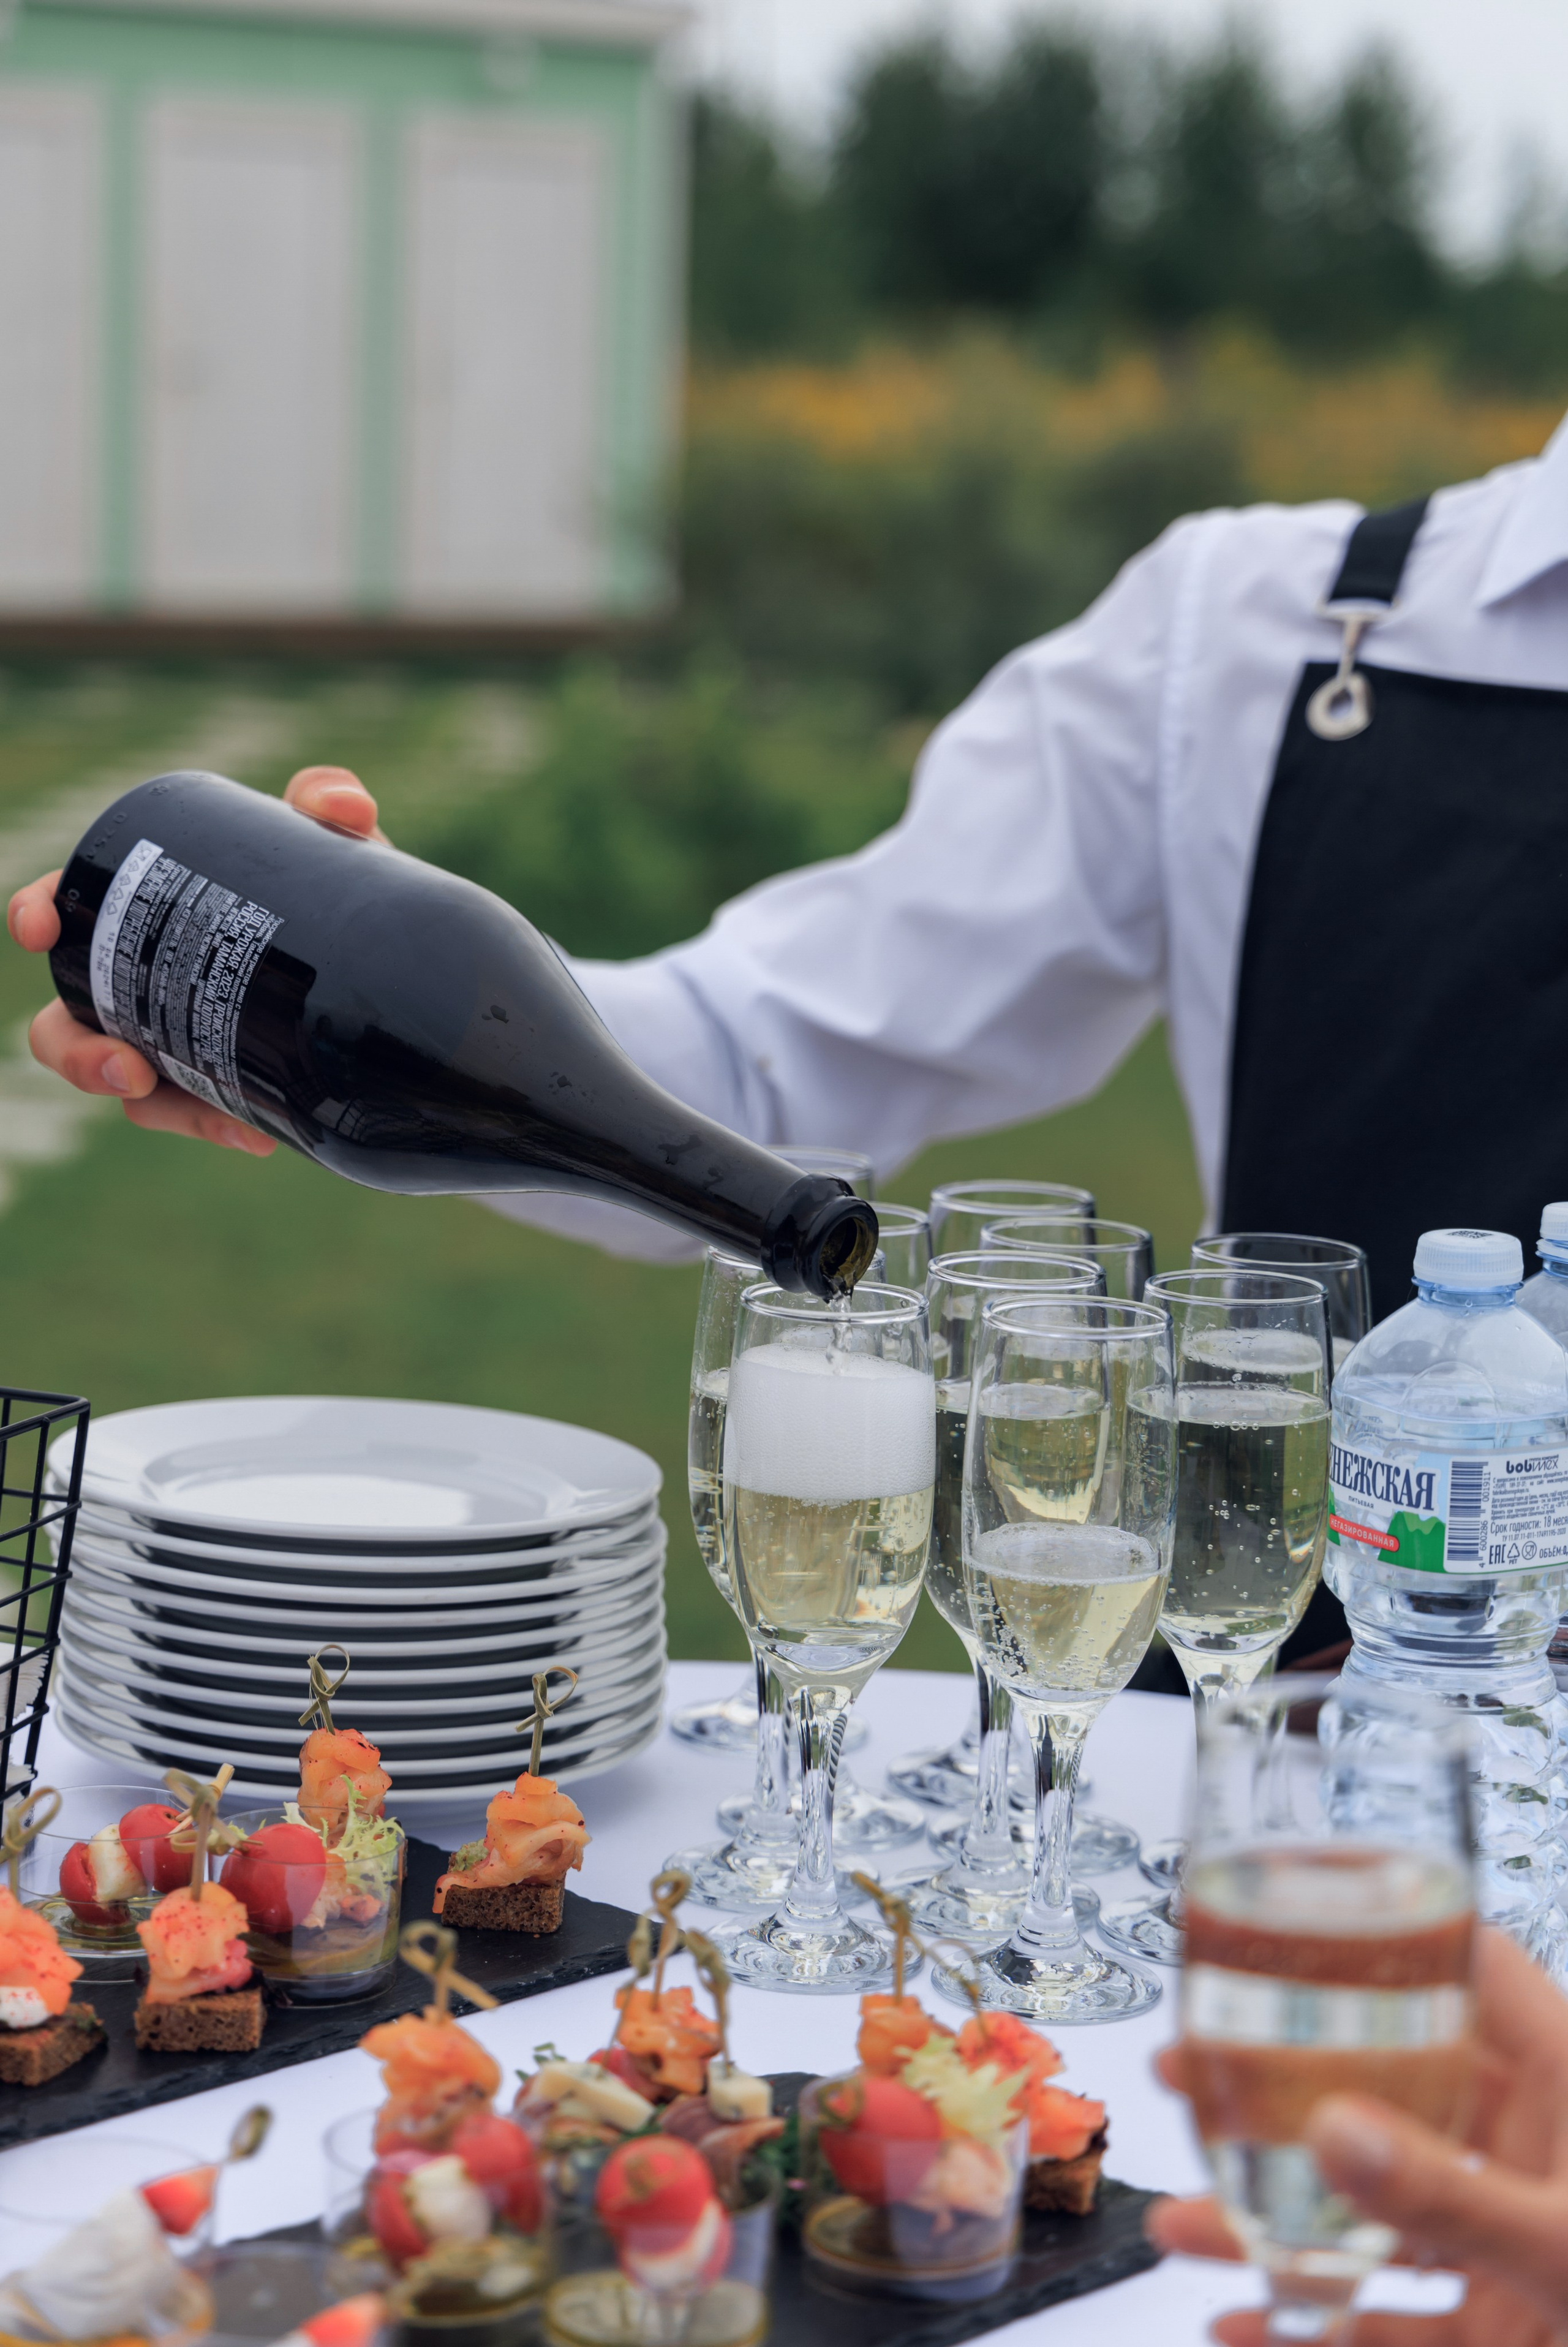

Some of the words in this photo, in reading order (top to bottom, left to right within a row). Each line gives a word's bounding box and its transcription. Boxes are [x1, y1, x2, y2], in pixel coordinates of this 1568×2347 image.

[135, 854, 176, 904] ЧРЕЗМЕРНОЕ
[167, 863, 185, 882] Срок
[148, 879, 172, 916] годности
[116, 896, 149, 958] УПОТРЕБЛЕНИЕ
[144, 913, 154, 926] не
[168, 907, 192, 950] ИЗГОТОВИТЕЛЬ:
[219, 907, 239, 932] ИГРИСТОЕ
[224, 901, 257, 942] РОССИЯ,
[247, 905, 270, 929] ГОД
[211, 931, 224, 948] ВИНО
[225, 925, 255, 972] УРОЖАЯ:
[255, 917, 285, 954] Российское
[164, 949, 173, 964] ООО
[205, 939, 233, 1001] ТАМАНСКИЙ
[236, 940, 259, 978] Таманский
[242, 953, 260, 985] игристое
[225, 976, 241, 1020] полуостров»
[236, 985, 247, 1003] вино
[212, 1000, 226, 1082] ПРОИСХОЖДЕНИЕ
[228, 1010, 240, 1058] защищенным
[1330, 1442, 1436, 1511] НЕЖСКАЯ
[1482, 1471, 1491, 1502] 001911
[1348, 1495, 1374, 1509] ПИТЬЕВАЯ
[1330, 1518, 1394, 1548] НЕГАЗИРОВАННАЯ
[1479, 1520, 1488, 1551] 600286
[1491, 1522, 1507, 1536] Срок
[1509, 1520, 1542, 1533] годности:
[1544, 1515, 1551, 1528] 18
